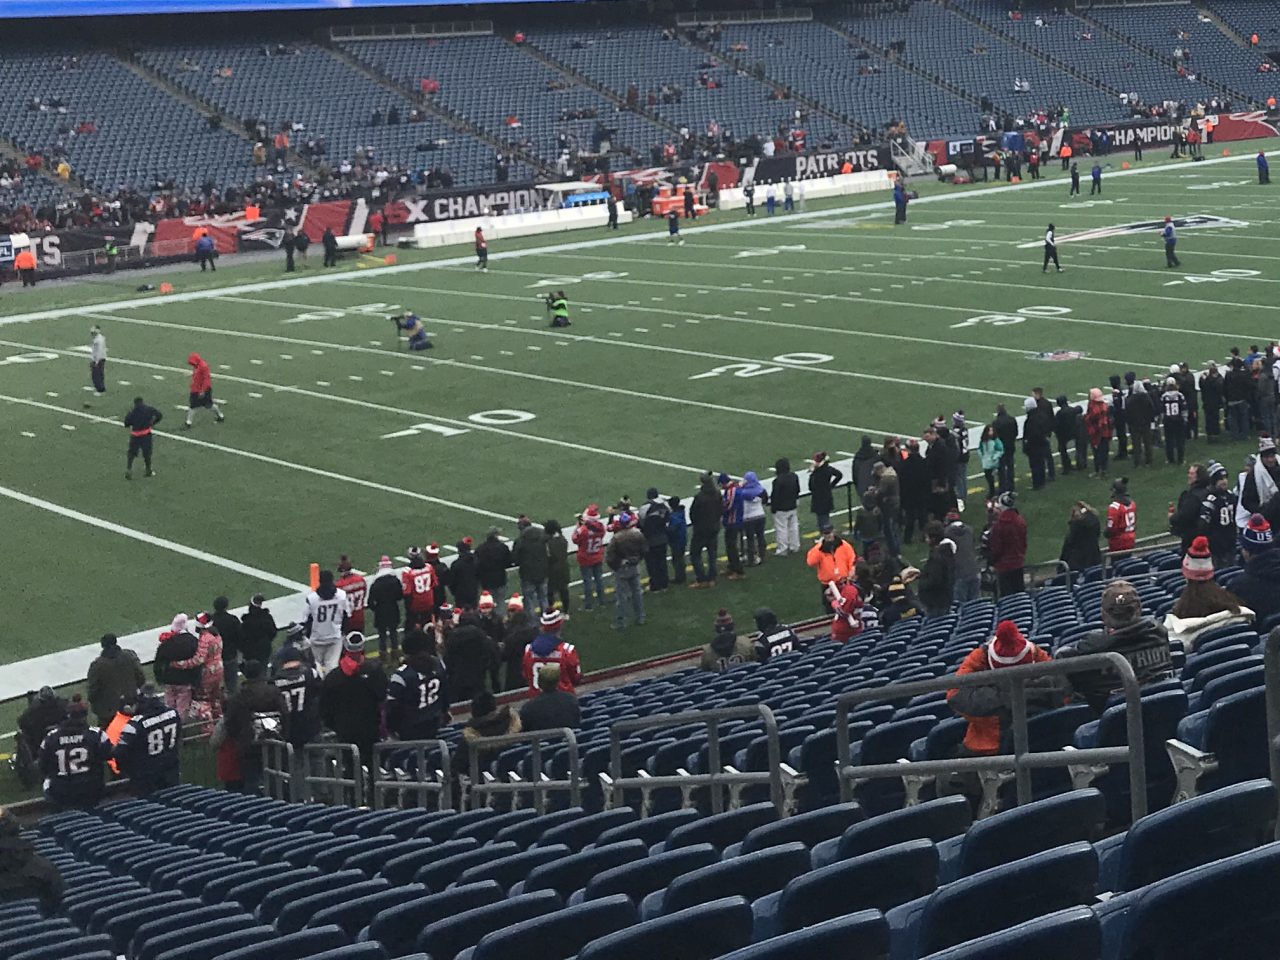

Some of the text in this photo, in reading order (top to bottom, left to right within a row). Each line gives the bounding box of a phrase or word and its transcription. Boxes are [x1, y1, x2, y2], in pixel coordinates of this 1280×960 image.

[966, 304, 1073, 327] 30
[715, 351, 835, 379] 20
[408, 407, 538, 438] 10
[317, 603, 339, 623] 87
[418, 678, 441, 709] 12
[147, 723, 178, 757] 87
[55, 746, 90, 777] 12
